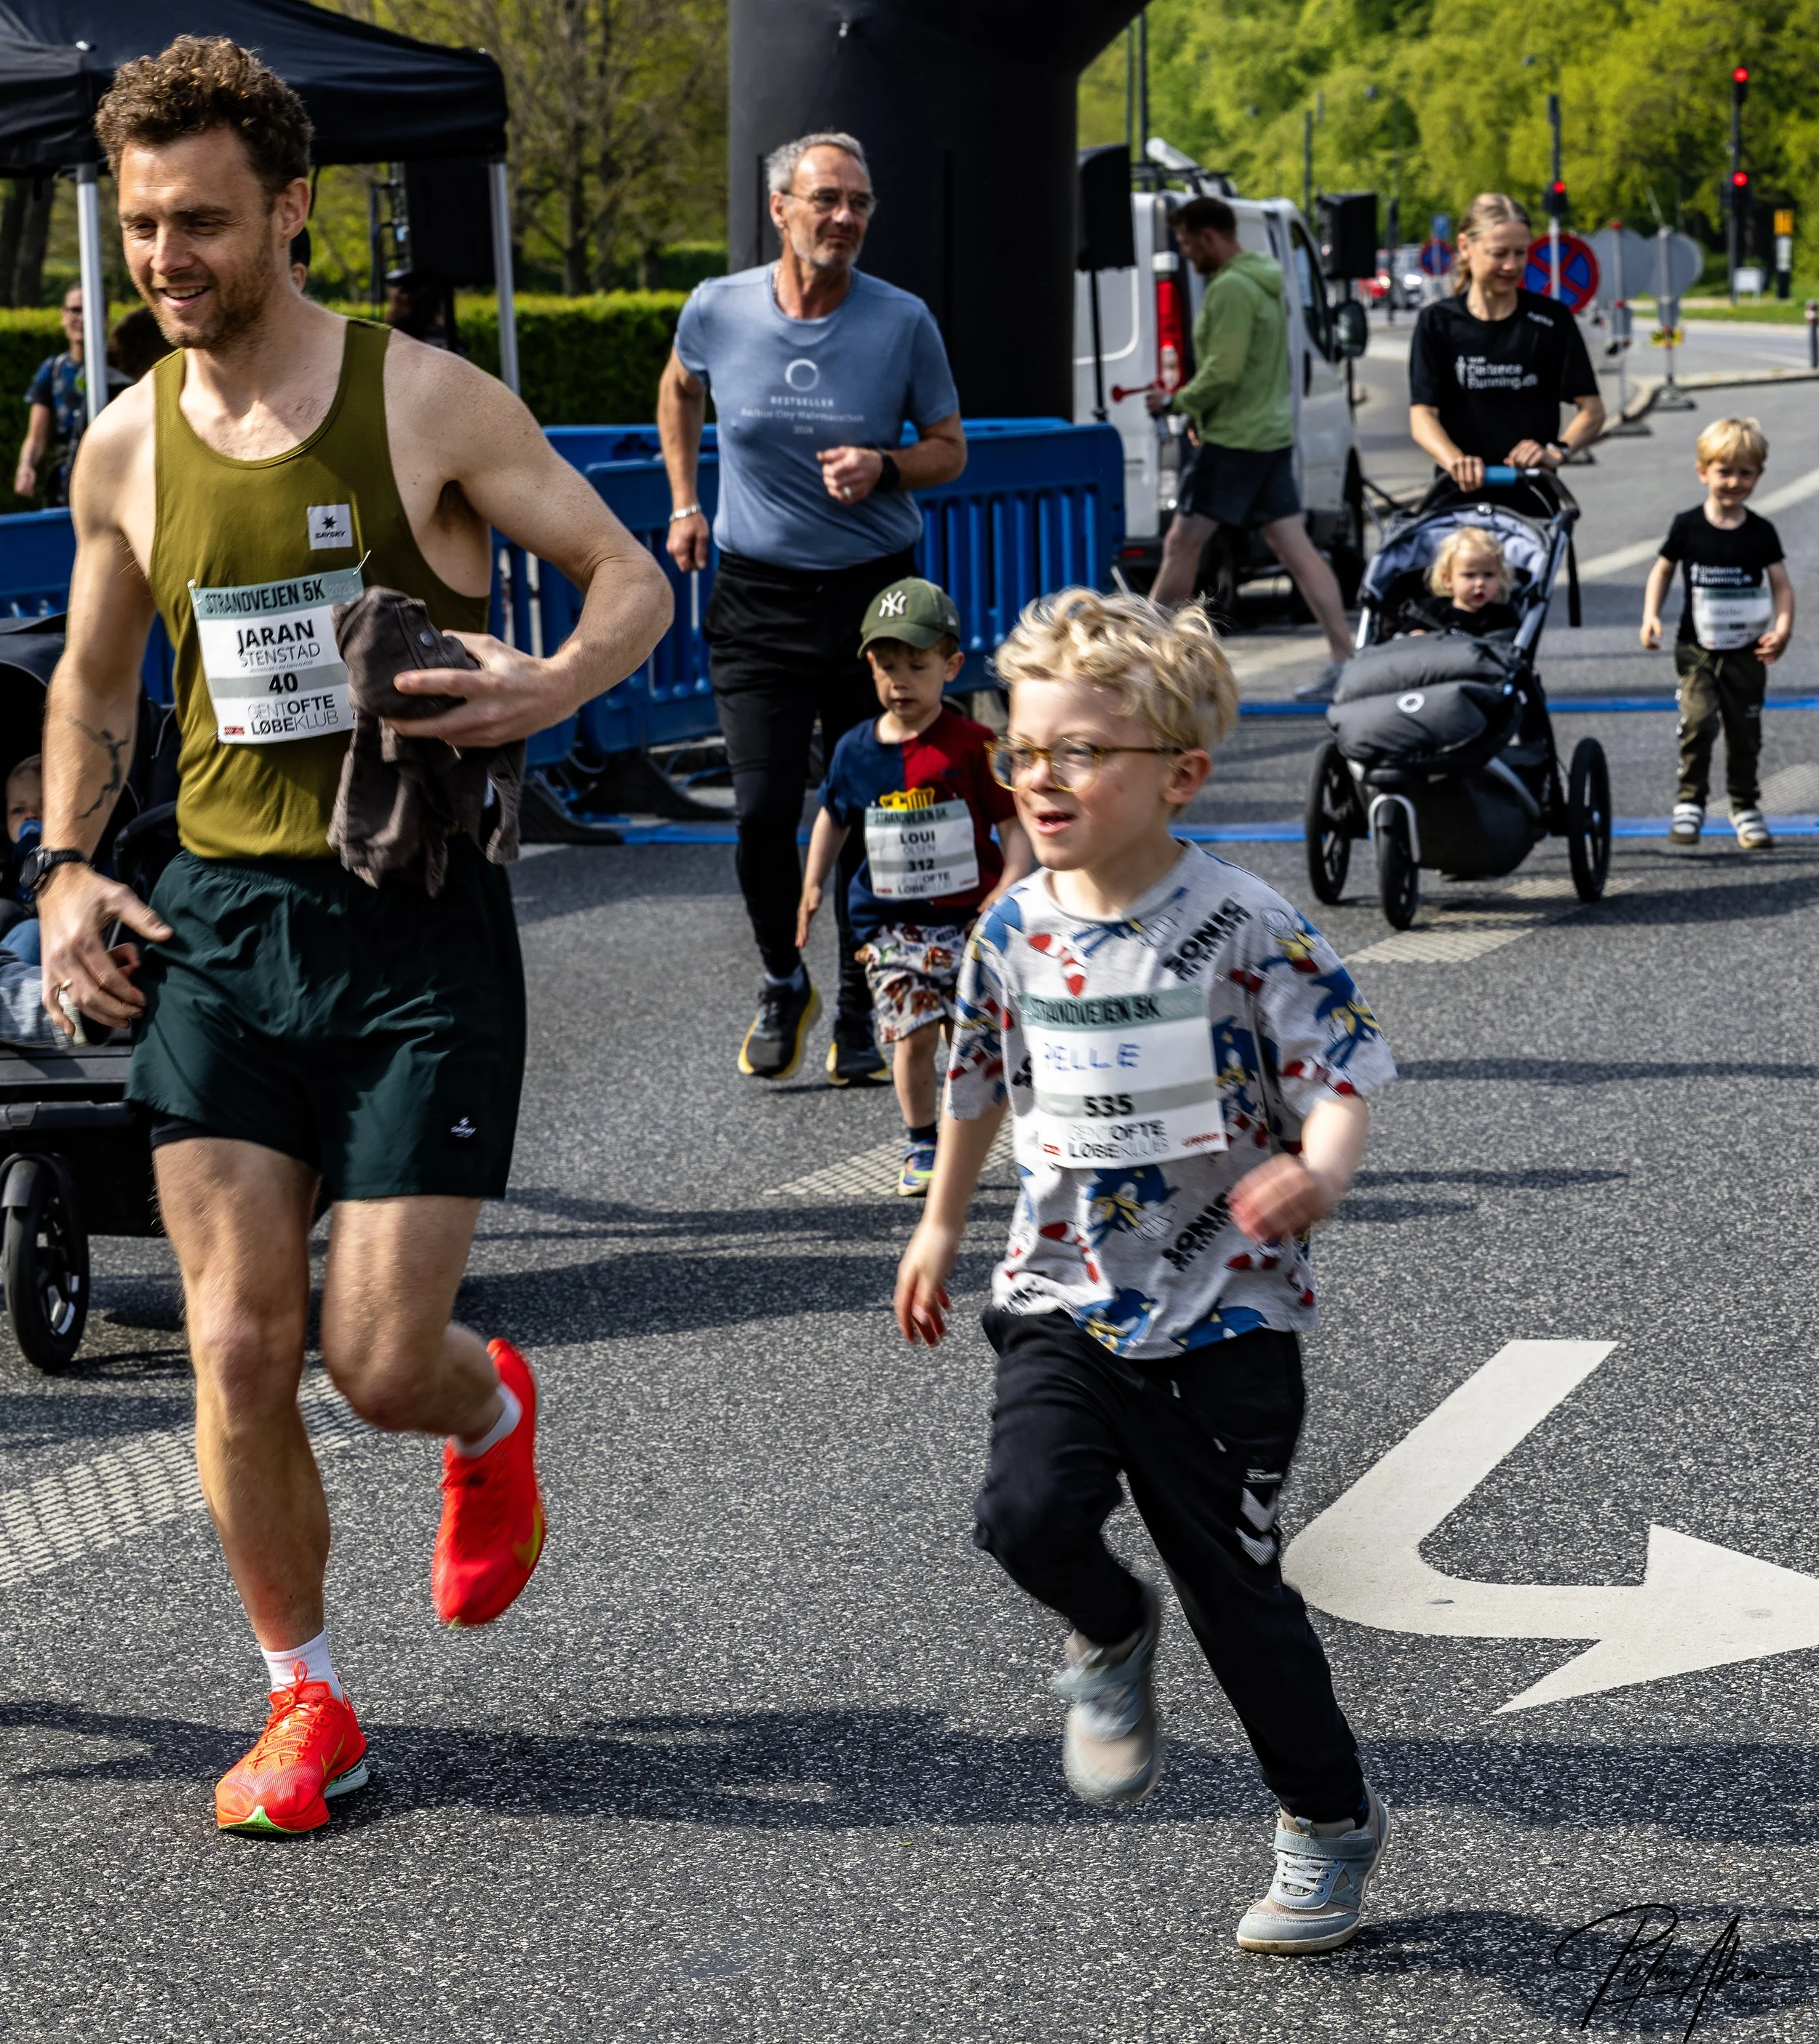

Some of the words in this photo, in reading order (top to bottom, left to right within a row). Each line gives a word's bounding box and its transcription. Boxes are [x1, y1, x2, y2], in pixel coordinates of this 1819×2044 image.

[770, 395, 835, 407] BESTSELLER
[774, 409, 795, 422] City
[205, 583, 300, 615] STRANDVEJEN
[303, 578, 327, 602] 5K
[878, 590, 907, 618] NY
[236, 618, 316, 656] JARAN
[239, 642, 321, 668] STENSTAD
[268, 671, 299, 695] 40
[248, 693, 336, 720] GENTOFTE
[250, 709, 339, 736] LØBEKLUB
[899, 830, 936, 845] LOUI
[907, 858, 936, 872] 312
[1043, 1042, 1142, 1071] PELLE
[1082, 1093, 1136, 1118] 535
[1282, 1837, 1323, 1852] mikk-line
